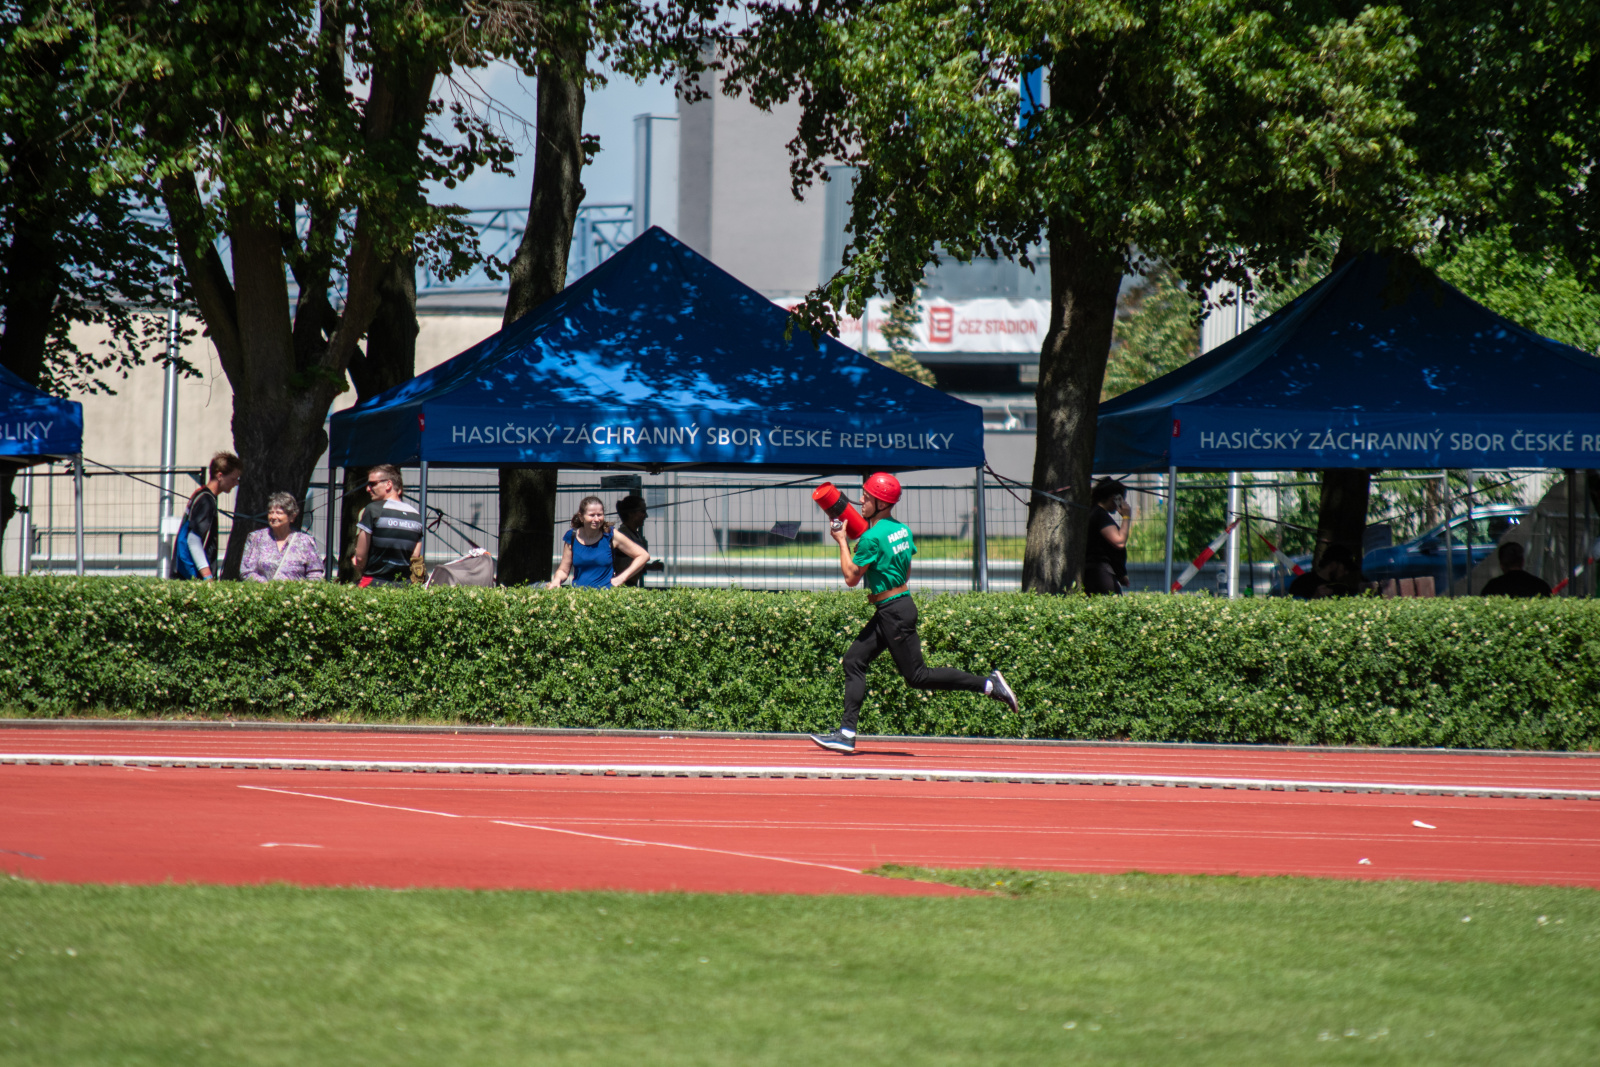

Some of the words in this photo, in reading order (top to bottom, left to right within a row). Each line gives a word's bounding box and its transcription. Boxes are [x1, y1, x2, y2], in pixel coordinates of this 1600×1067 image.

[985, 319, 1038, 334] STADION
[0, 421, 53, 440] LIKY
[452, 422, 557, 444] HASIČSKÝ
[563, 422, 700, 445] ZÁCHRANNÝ
[707, 427, 762, 446] SBOR
[768, 425, 832, 448] ČESKÉ
[840, 432, 954, 450] REPUBLIKY
[1200, 428, 1303, 449] HASIČSKÝ
[1308, 429, 1444, 450] ZÁCHRANNÝ
[1450, 433, 1505, 451] SBOR
[1511, 429, 1574, 451] ČESKÉ
